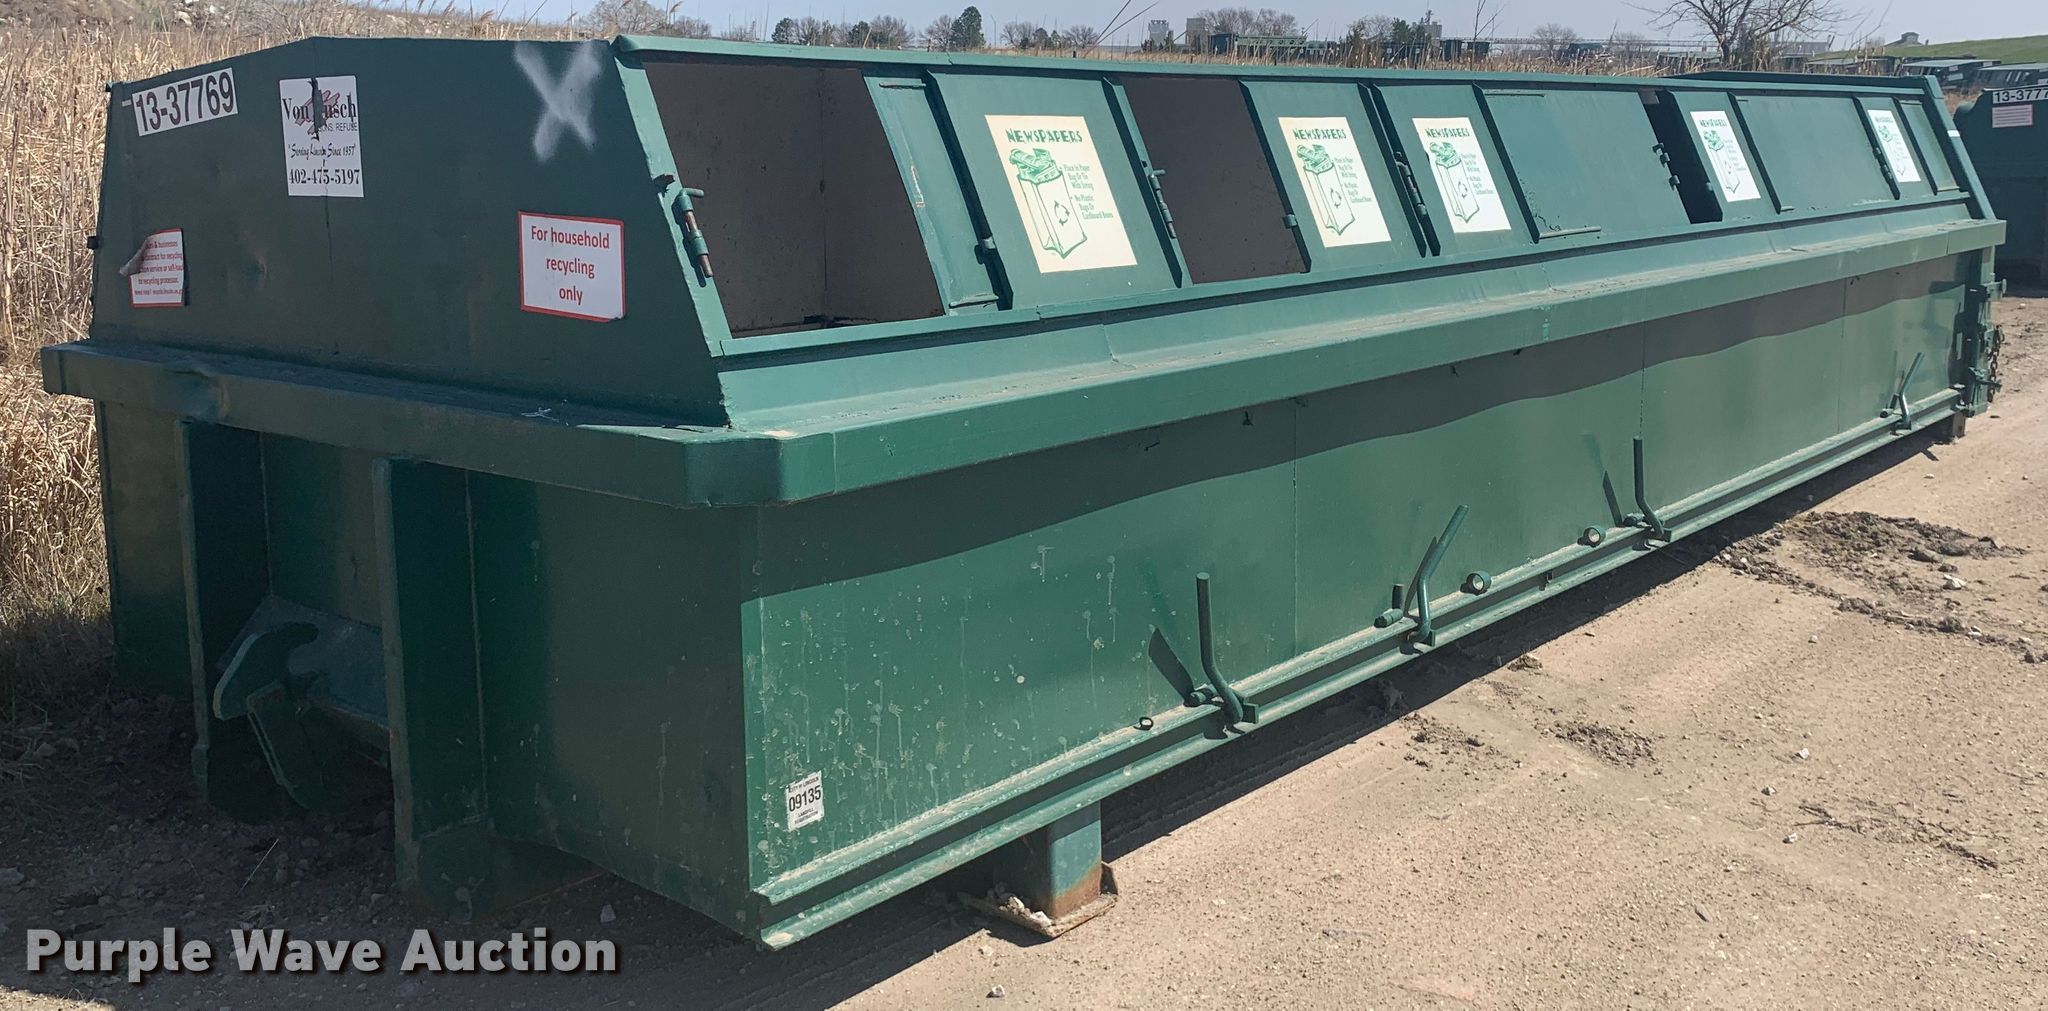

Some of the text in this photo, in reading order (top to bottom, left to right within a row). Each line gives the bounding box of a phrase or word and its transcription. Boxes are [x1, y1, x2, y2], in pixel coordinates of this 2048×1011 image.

[136, 71, 234, 132] 13-37769
[282, 92, 358, 121] Von usch
[1005, 128, 1083, 144] NEWSPAPERS
[1292, 128, 1347, 140] NEWSPAPERS
[1425, 127, 1470, 138] NEWSPAPERS
[327, 142, 342, 158] Since
[289, 168, 360, 184] 402-475-5197
[531, 225, 609, 248] For household
[546, 258, 595, 279] recycling
[559, 285, 583, 305] only
[789, 784, 821, 812] 09135
